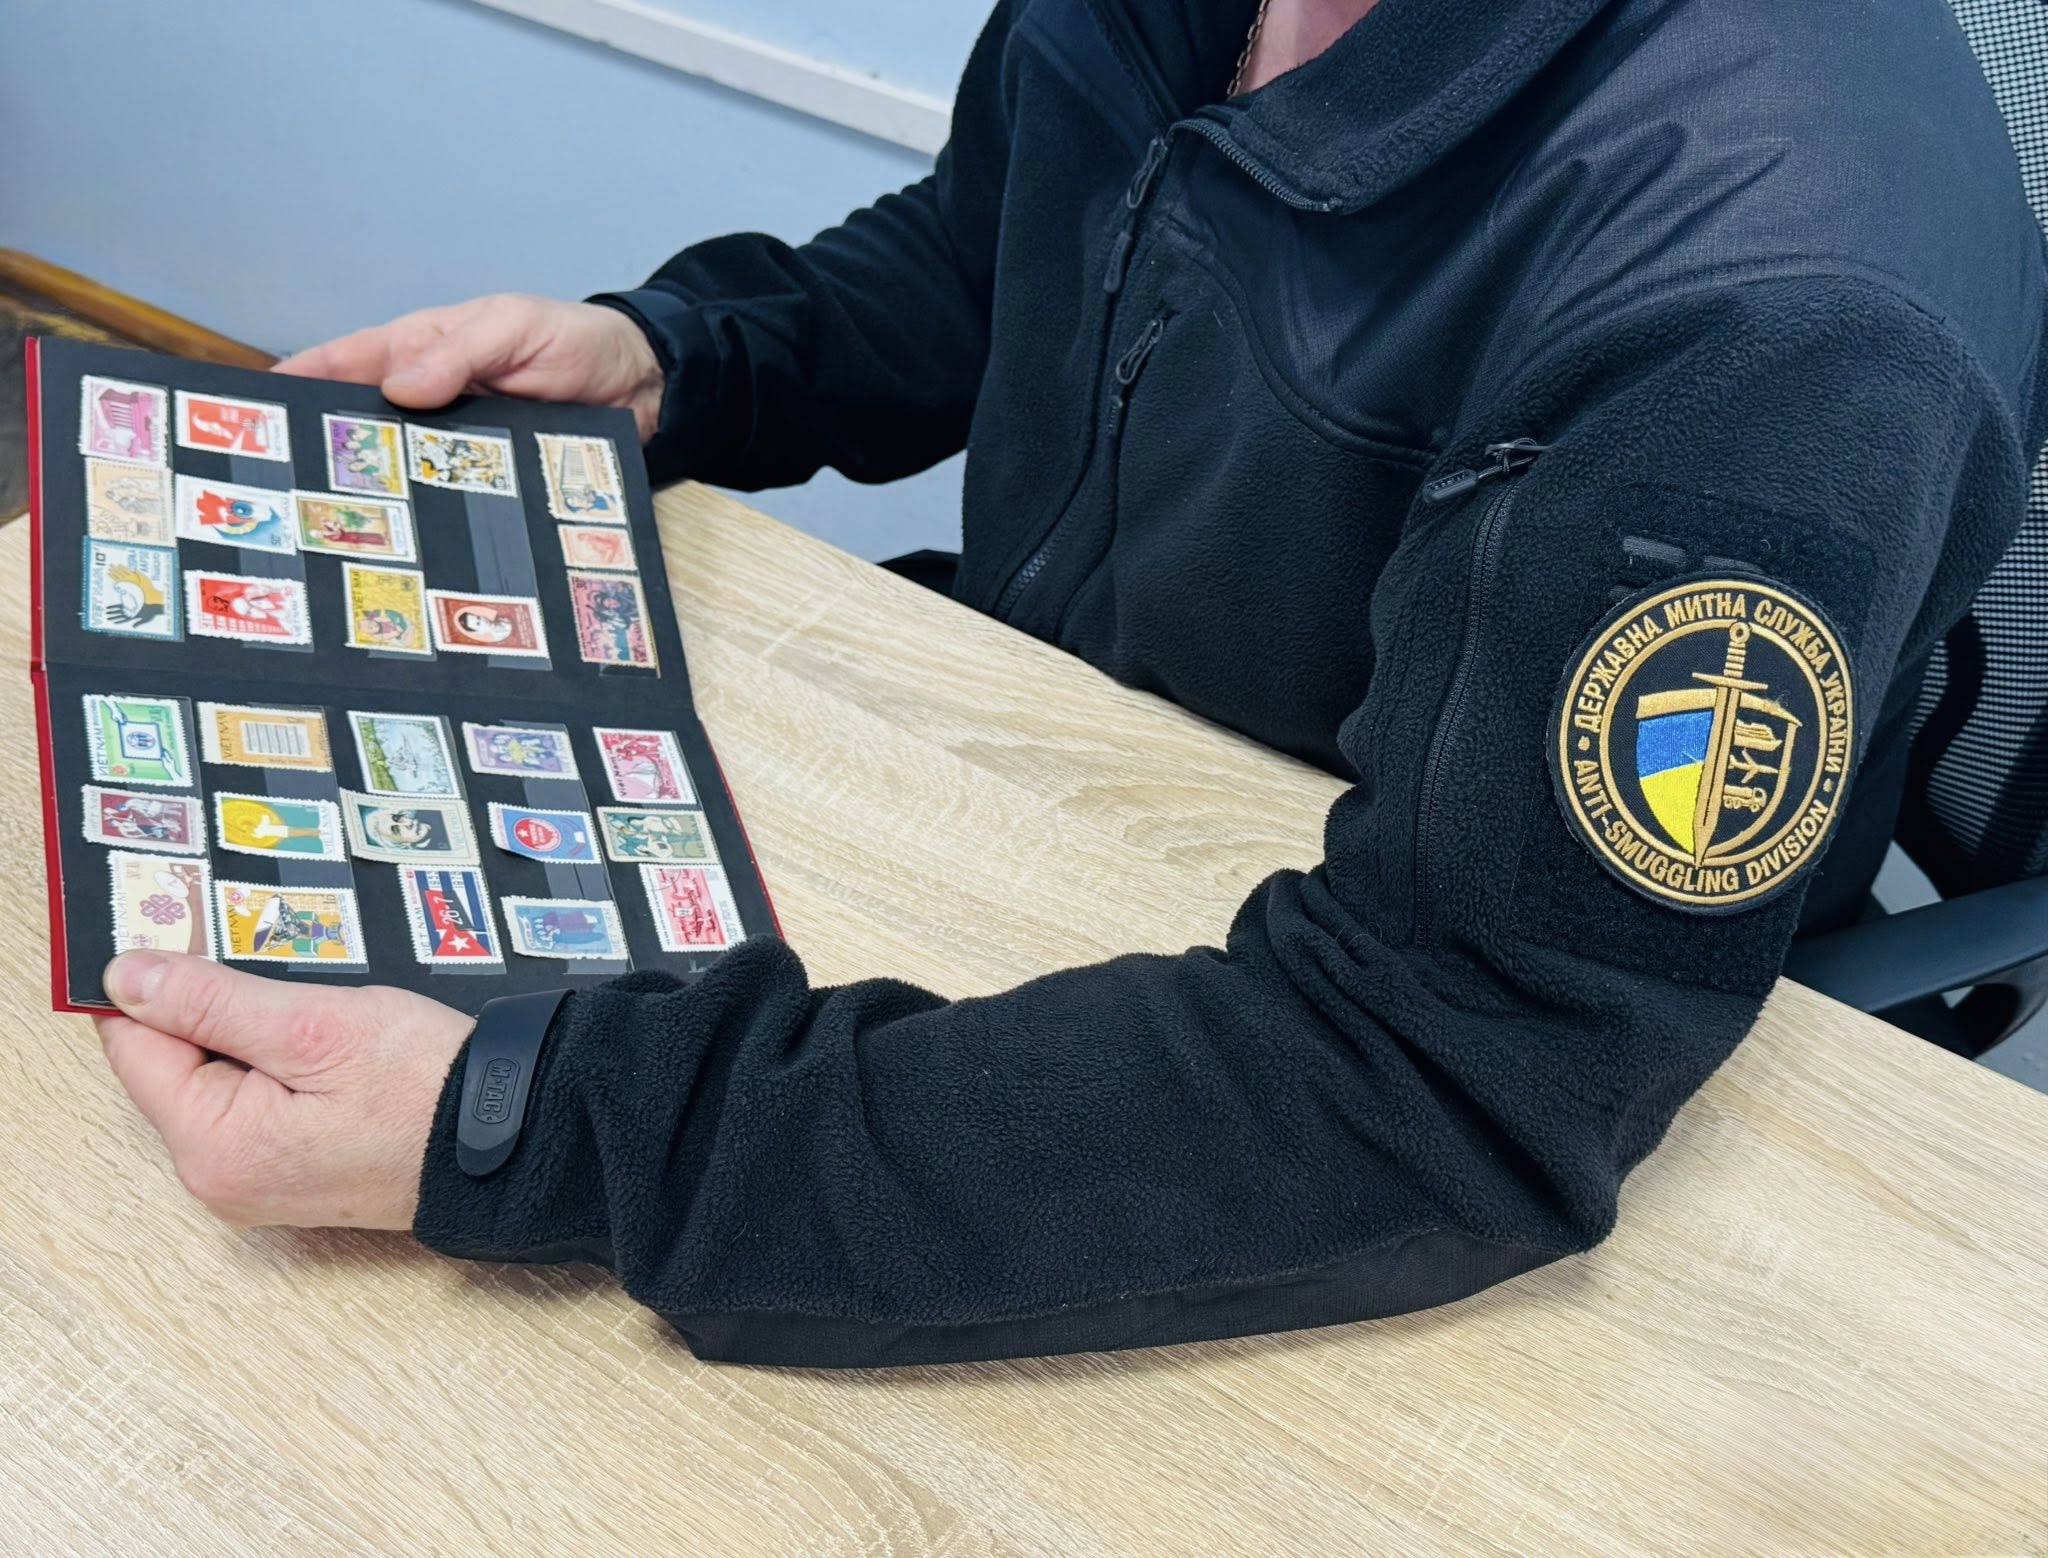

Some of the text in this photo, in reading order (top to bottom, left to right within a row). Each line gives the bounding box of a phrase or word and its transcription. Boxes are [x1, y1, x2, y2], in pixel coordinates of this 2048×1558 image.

[1574, 592, 1848, 773] ДЕРЖАВНА МИТНА СЛУЖБА УКРАЇНИ
[1574, 759, 1828, 893] ANTI-SMUGGLING DIVISION
[413, 907, 426, 929] NAM
[433, 896, 464, 925] 26-7
[482, 1065, 512, 1113] M-TAC
